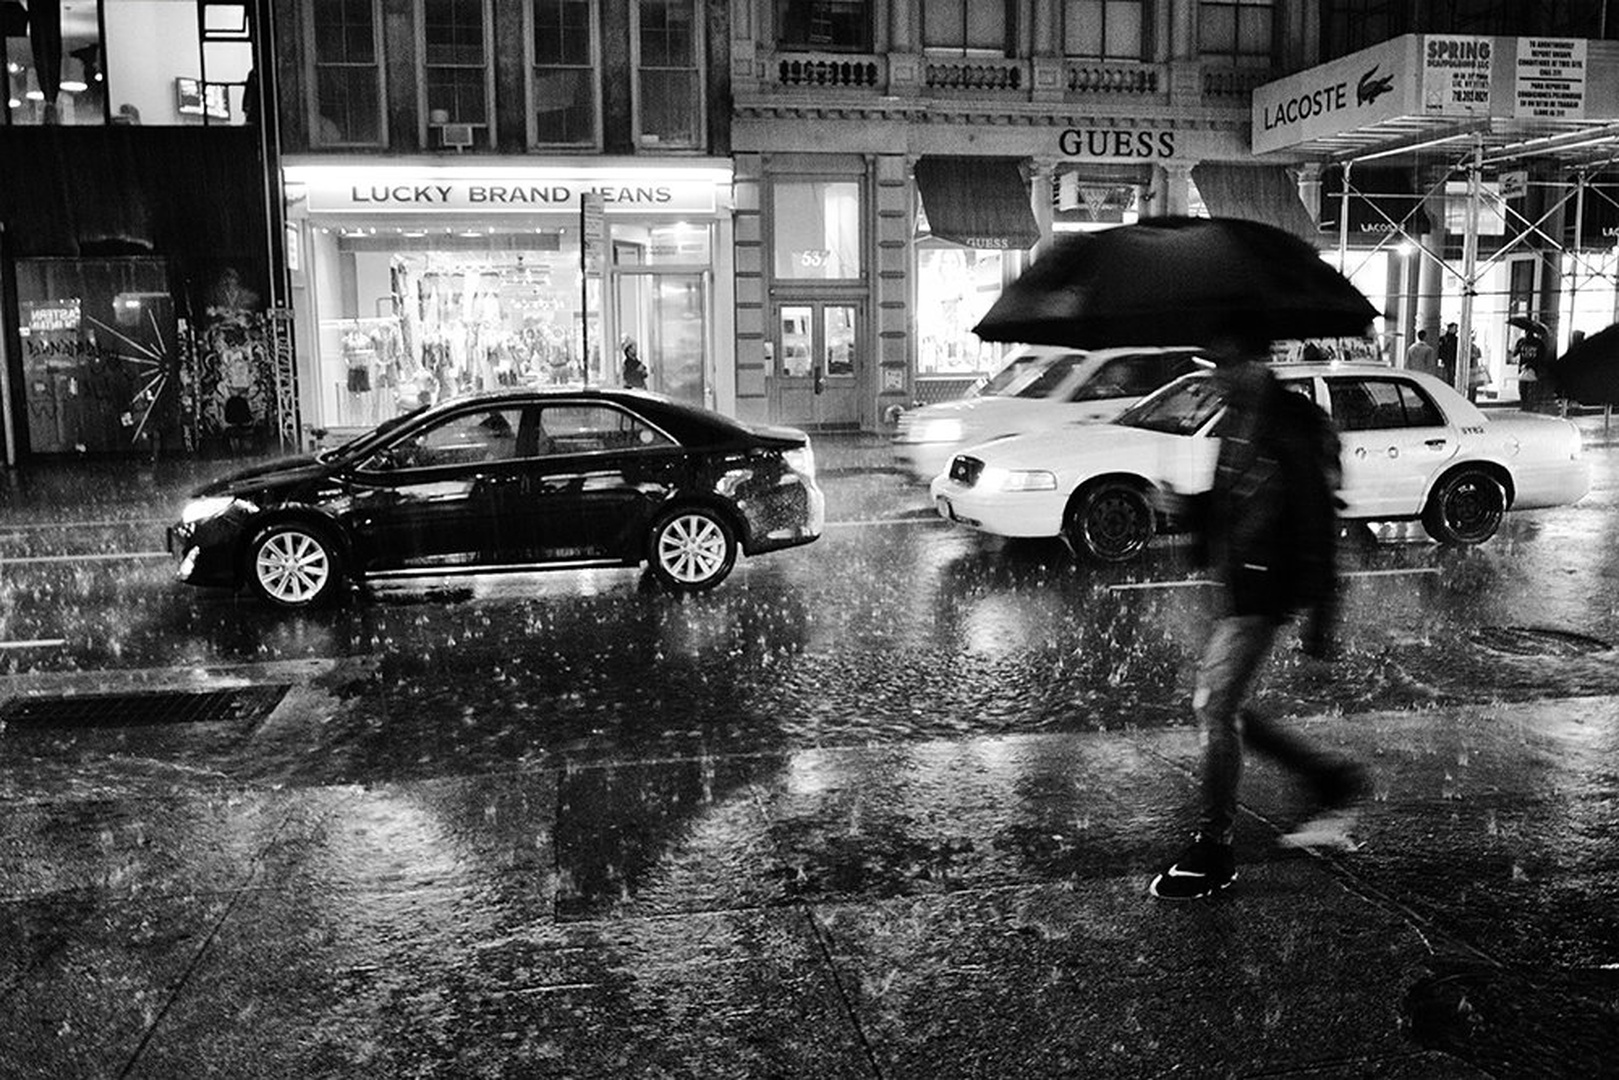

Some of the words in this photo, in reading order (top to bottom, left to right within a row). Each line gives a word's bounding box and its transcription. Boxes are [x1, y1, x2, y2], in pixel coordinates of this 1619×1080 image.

[1427, 40, 1490, 60] SPRING
[1265, 82, 1347, 131] LACOSTE
[1059, 129, 1175, 158] GUESS
[352, 186, 452, 203] LUCKY
[469, 186, 570, 203] BRAND
[966, 237, 1009, 249] GUESS
